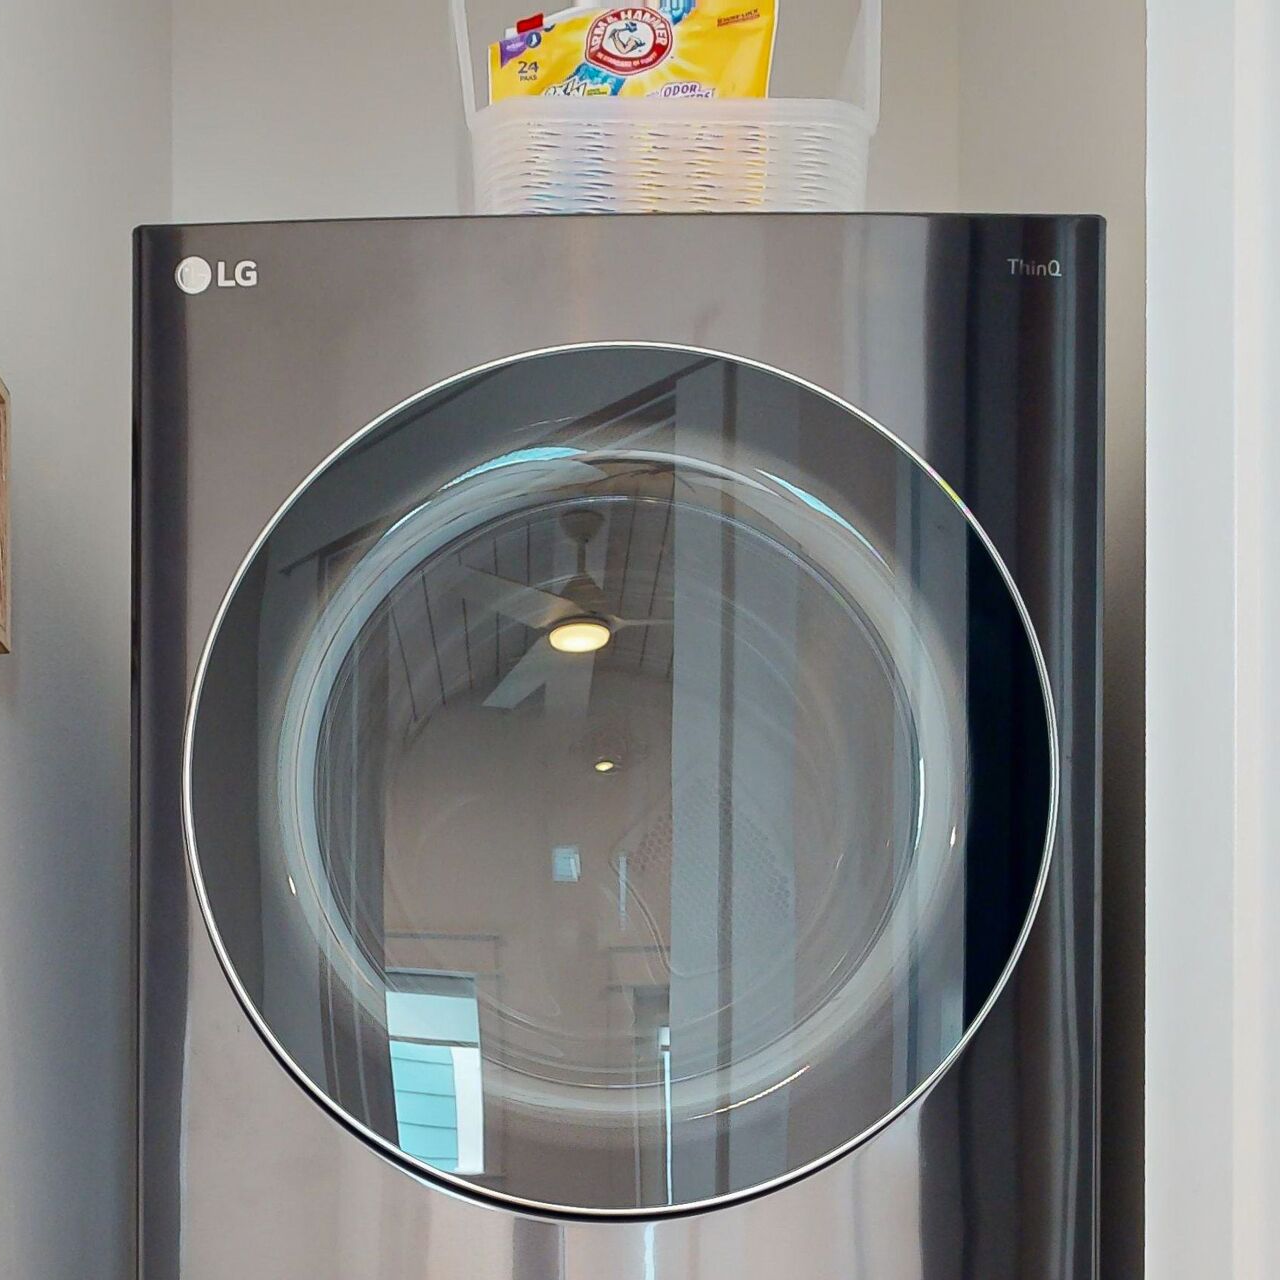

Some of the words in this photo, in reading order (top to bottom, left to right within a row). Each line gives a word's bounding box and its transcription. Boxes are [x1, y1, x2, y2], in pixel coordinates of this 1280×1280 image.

[620, 10, 669, 46] HAMMER
[518, 61, 539, 74] 24
[663, 84, 698, 98] ODOR
[217, 260, 258, 287] LG
[1006, 258, 1063, 277] ThinQ
